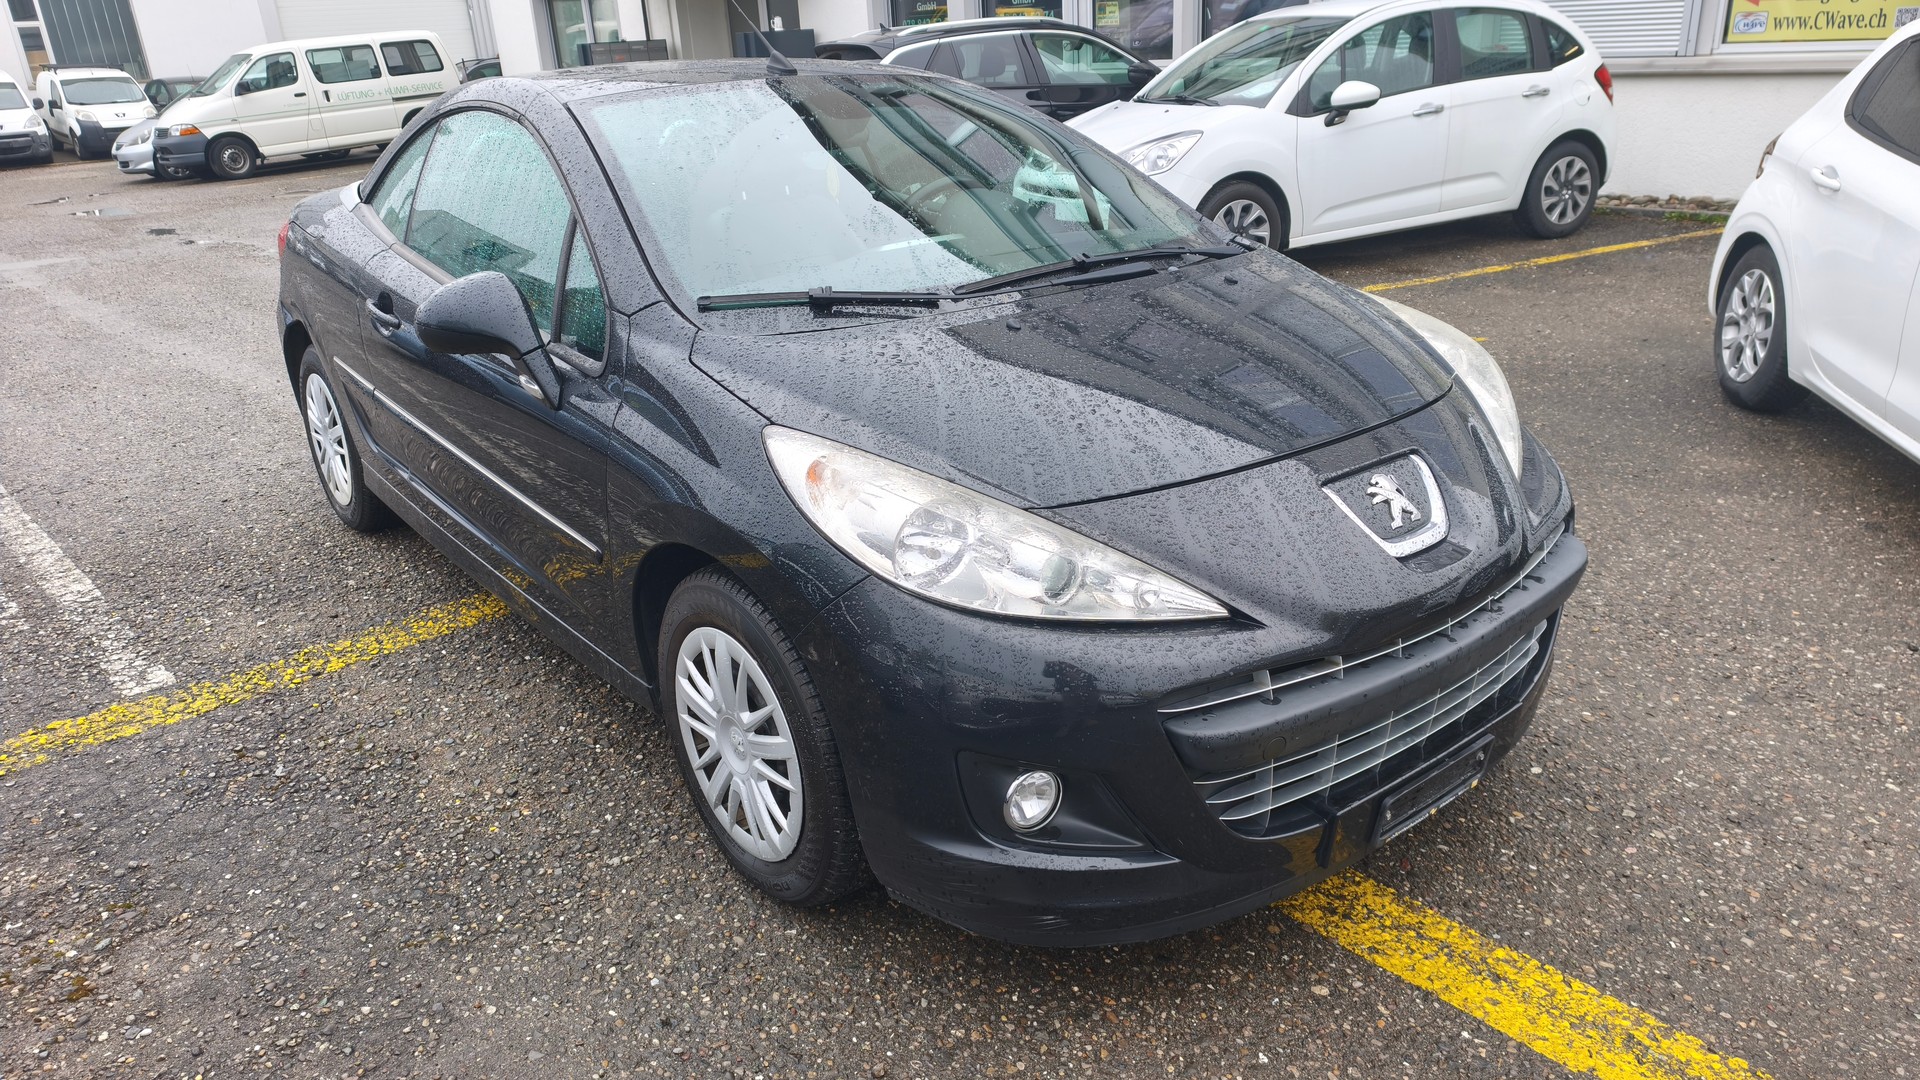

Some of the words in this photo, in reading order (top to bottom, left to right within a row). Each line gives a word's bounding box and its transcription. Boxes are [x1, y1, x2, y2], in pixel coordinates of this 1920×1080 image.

[916, 2, 937, 11] GmbH
[1773, 8, 1888, 31] www.CWave.ch
[337, 90, 375, 102] LÜFTUNG
[384, 81, 444, 96] KLIMA-SERVICE
